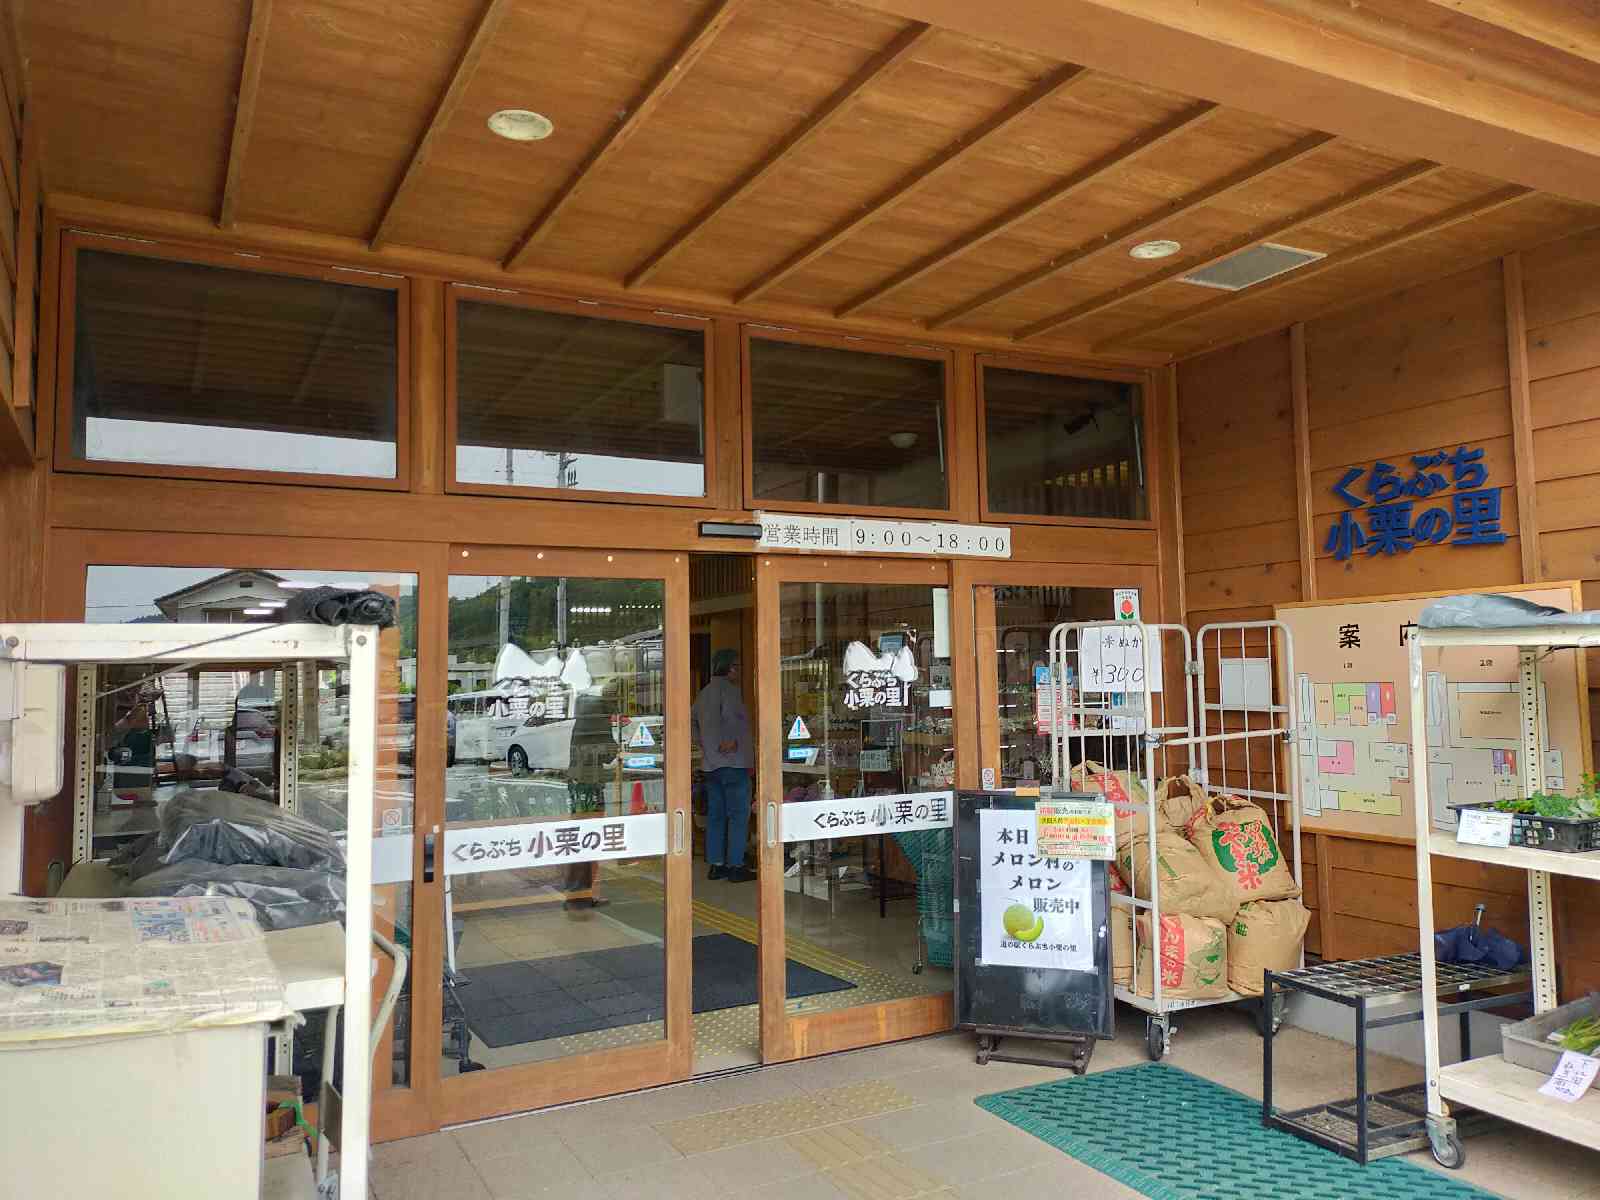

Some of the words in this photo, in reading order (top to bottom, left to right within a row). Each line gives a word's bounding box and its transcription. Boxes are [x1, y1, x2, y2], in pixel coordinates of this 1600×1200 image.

[1333, 446, 1488, 507] くらぶち
[763, 523, 839, 546] 営業時間
[1325, 488, 1507, 560] 小栗の里
[487, 696, 566, 720] 小栗の里
[843, 688, 902, 709] 小栗の里
[996, 828, 1029, 845] 本日
[1008, 875, 1062, 891] メロン
[1033, 898, 1080, 915] 販売中
